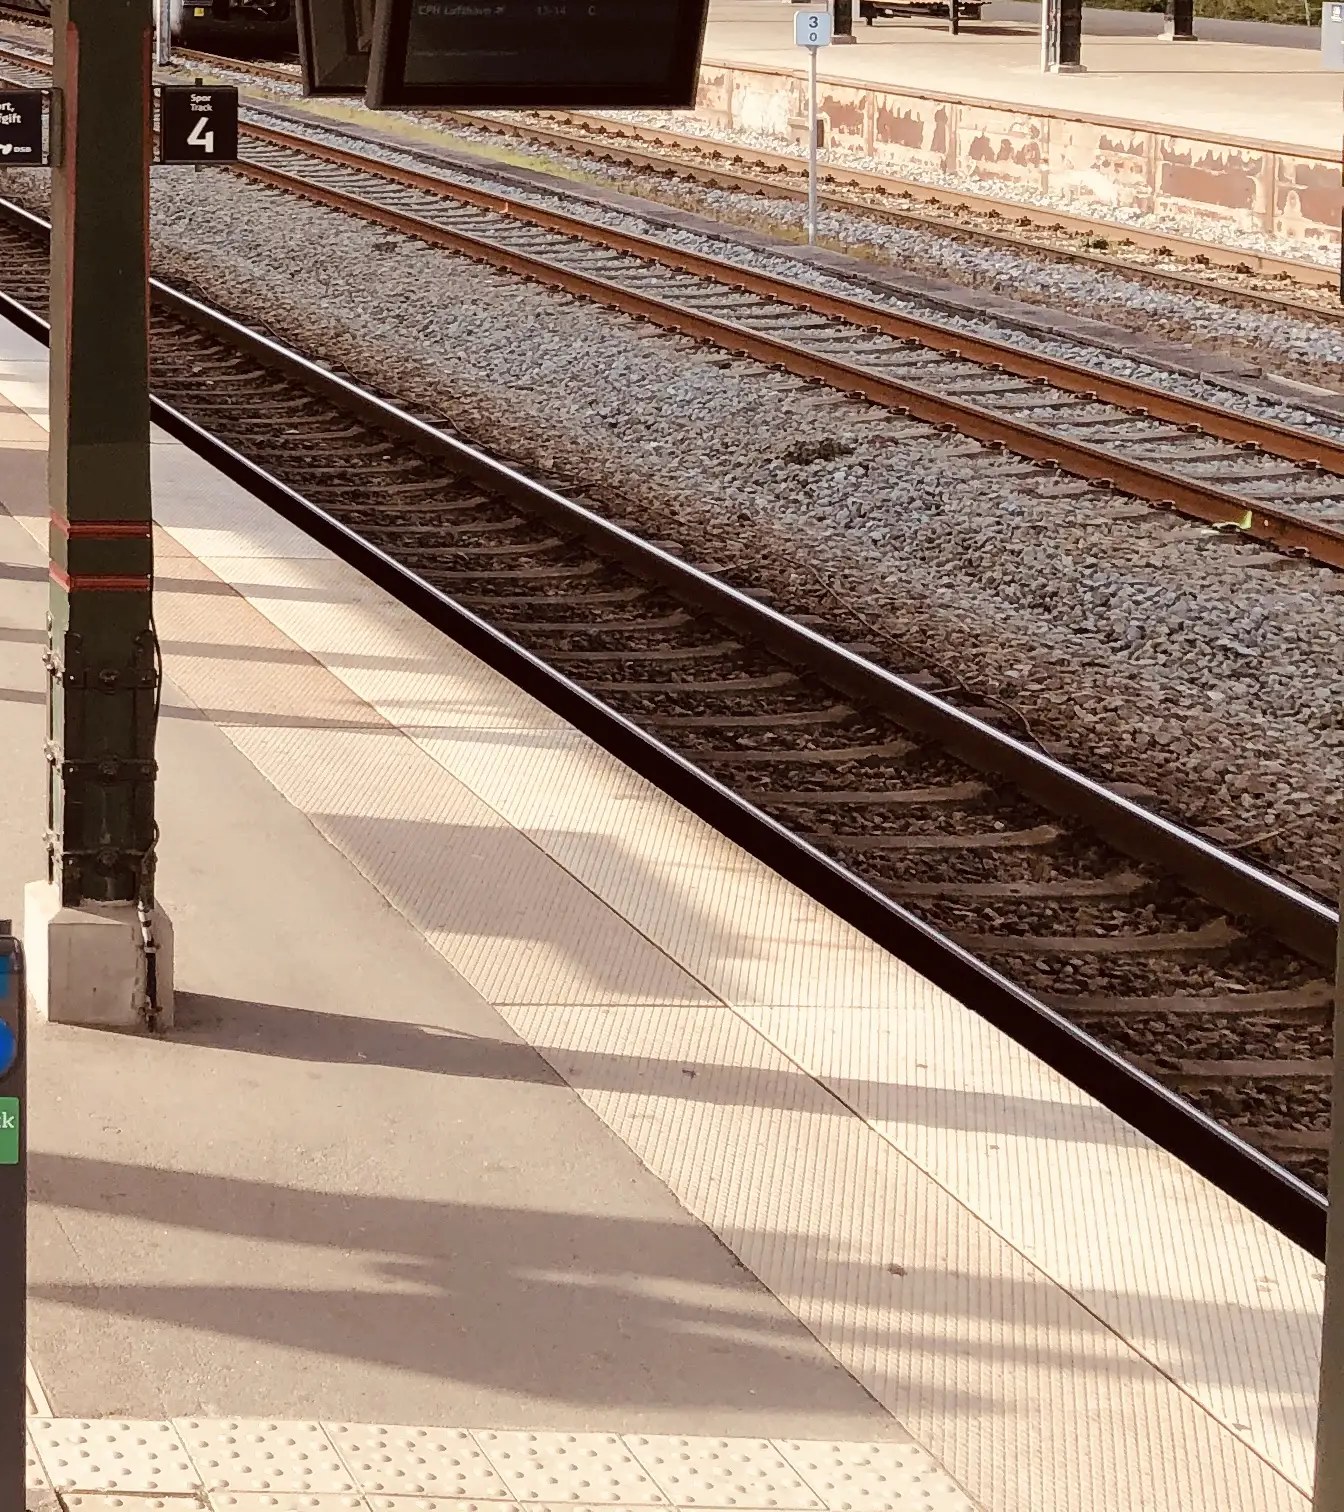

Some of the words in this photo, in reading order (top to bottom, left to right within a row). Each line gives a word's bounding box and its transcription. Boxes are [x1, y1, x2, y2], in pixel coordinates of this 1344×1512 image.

[808, 15, 819, 29] 3
[809, 32, 818, 42] 0
[190, 93, 212, 103] Spor
[190, 103, 213, 112] Track
[186, 116, 214, 153] 4
